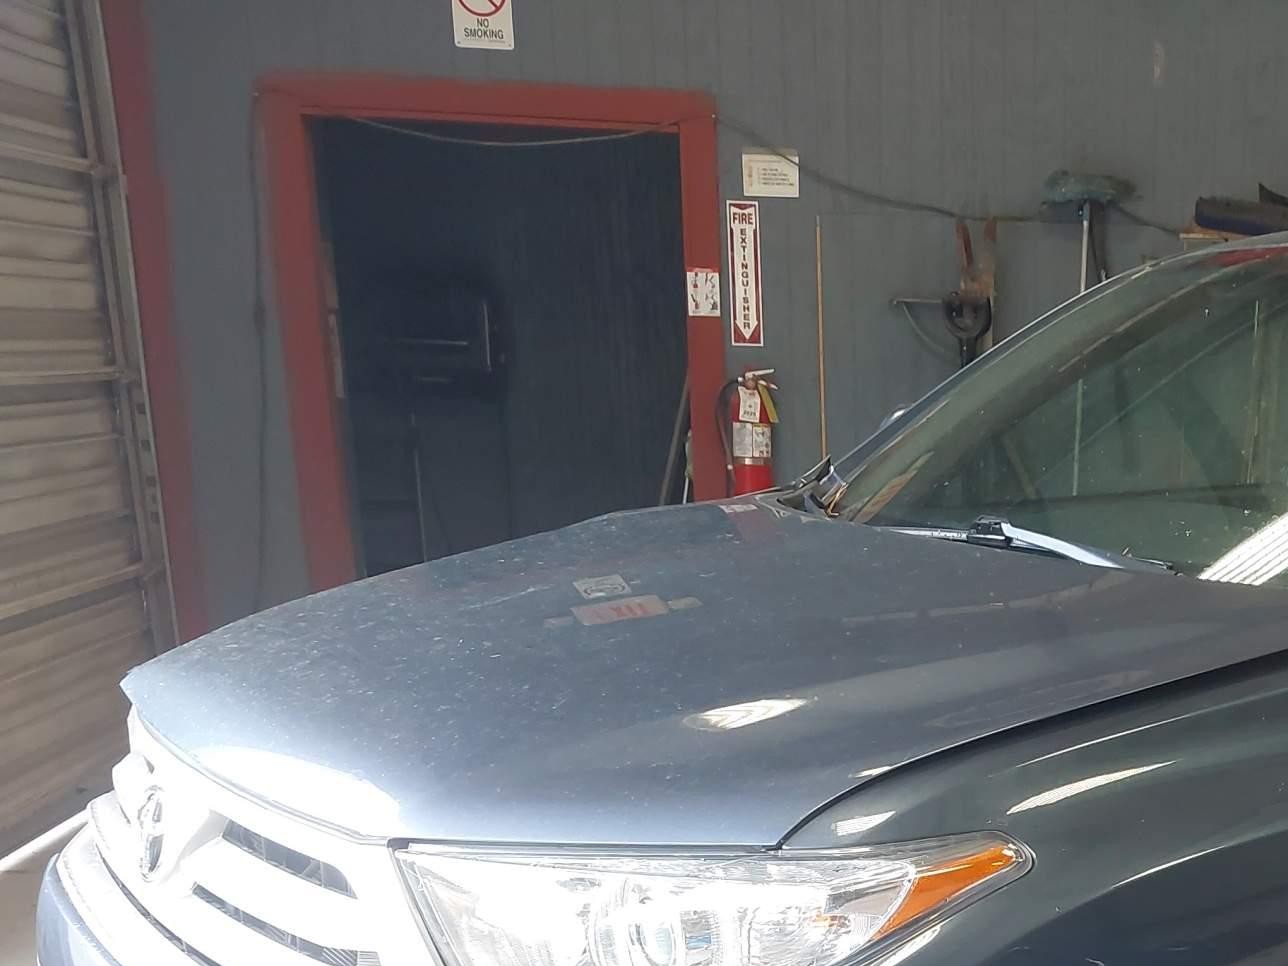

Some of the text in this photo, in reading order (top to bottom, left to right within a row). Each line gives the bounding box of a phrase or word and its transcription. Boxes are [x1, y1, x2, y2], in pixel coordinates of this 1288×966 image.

[477, 18, 489, 28] NO
[464, 28, 504, 39] SMOKING
[733, 212, 754, 225] FIRE
[740, 228, 751, 330] EXTINGUISHER
